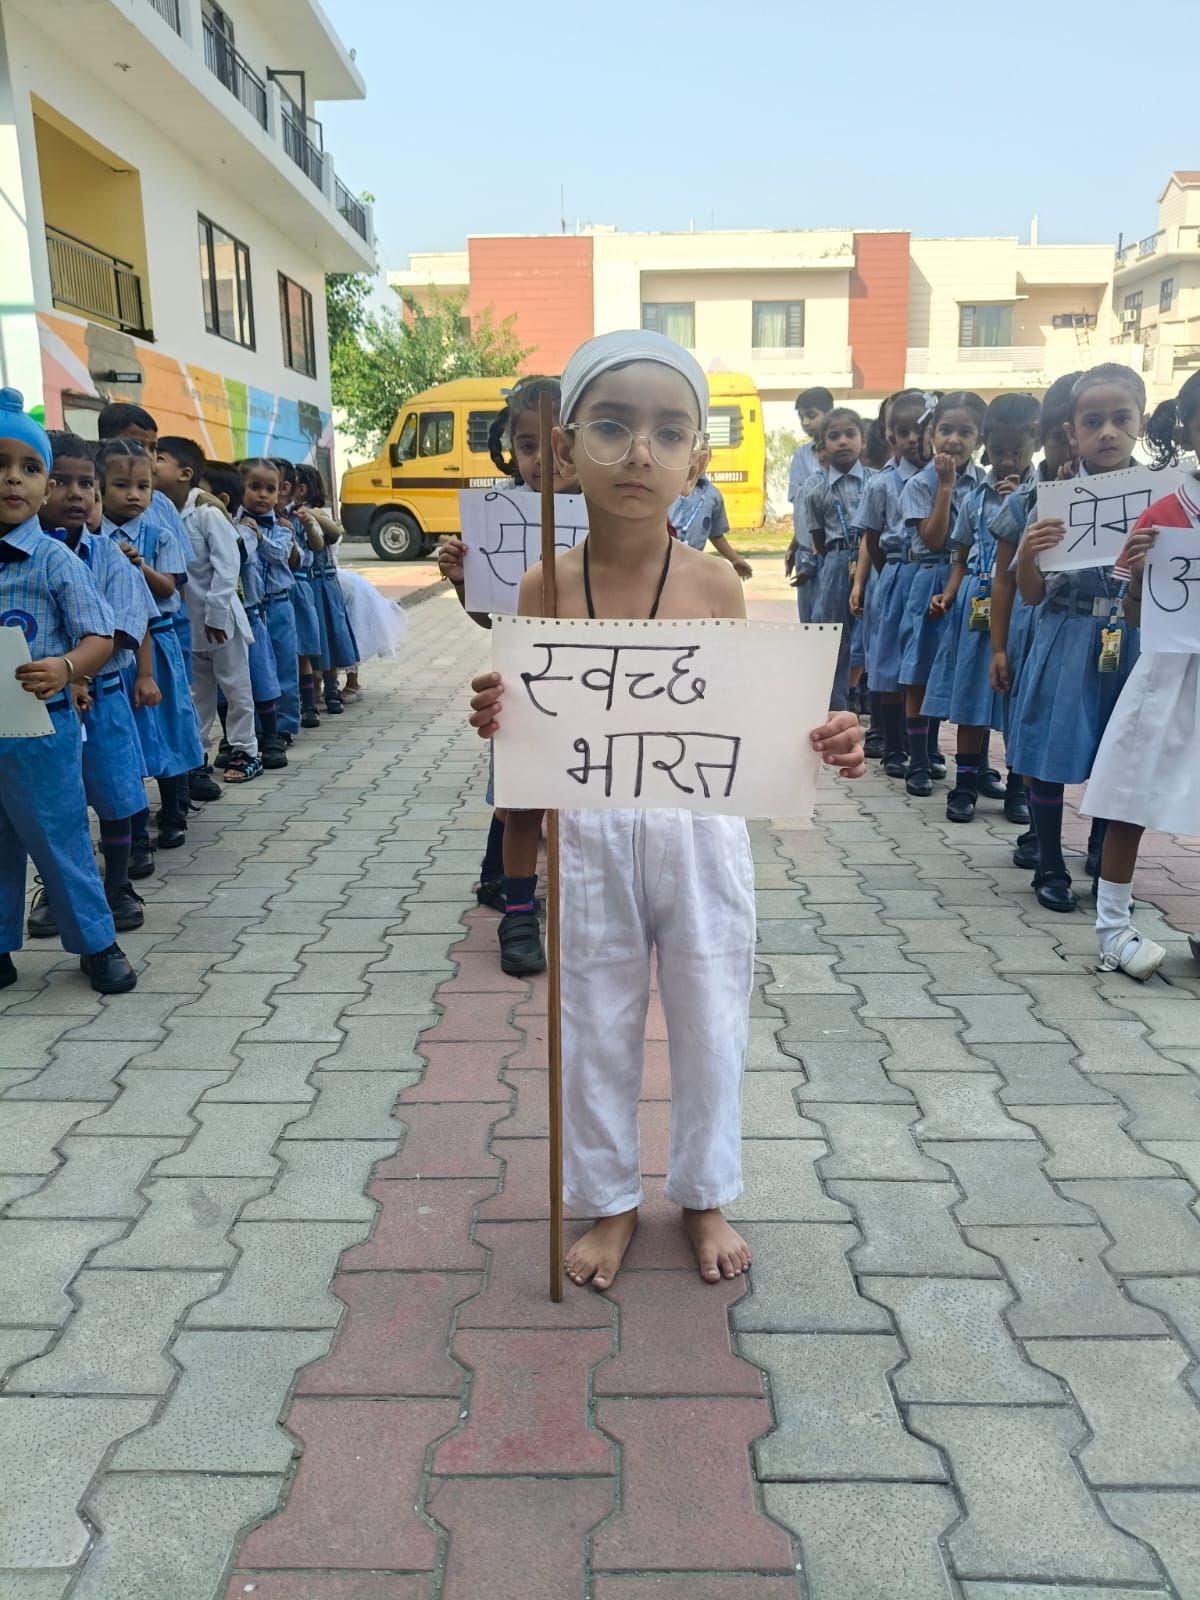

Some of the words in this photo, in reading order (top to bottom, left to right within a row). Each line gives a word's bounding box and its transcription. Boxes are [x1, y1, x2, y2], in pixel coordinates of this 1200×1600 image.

[1066, 486, 1152, 553] प्रेम
[520, 643, 706, 716] स्वच्छ
[566, 731, 741, 798] भारत
